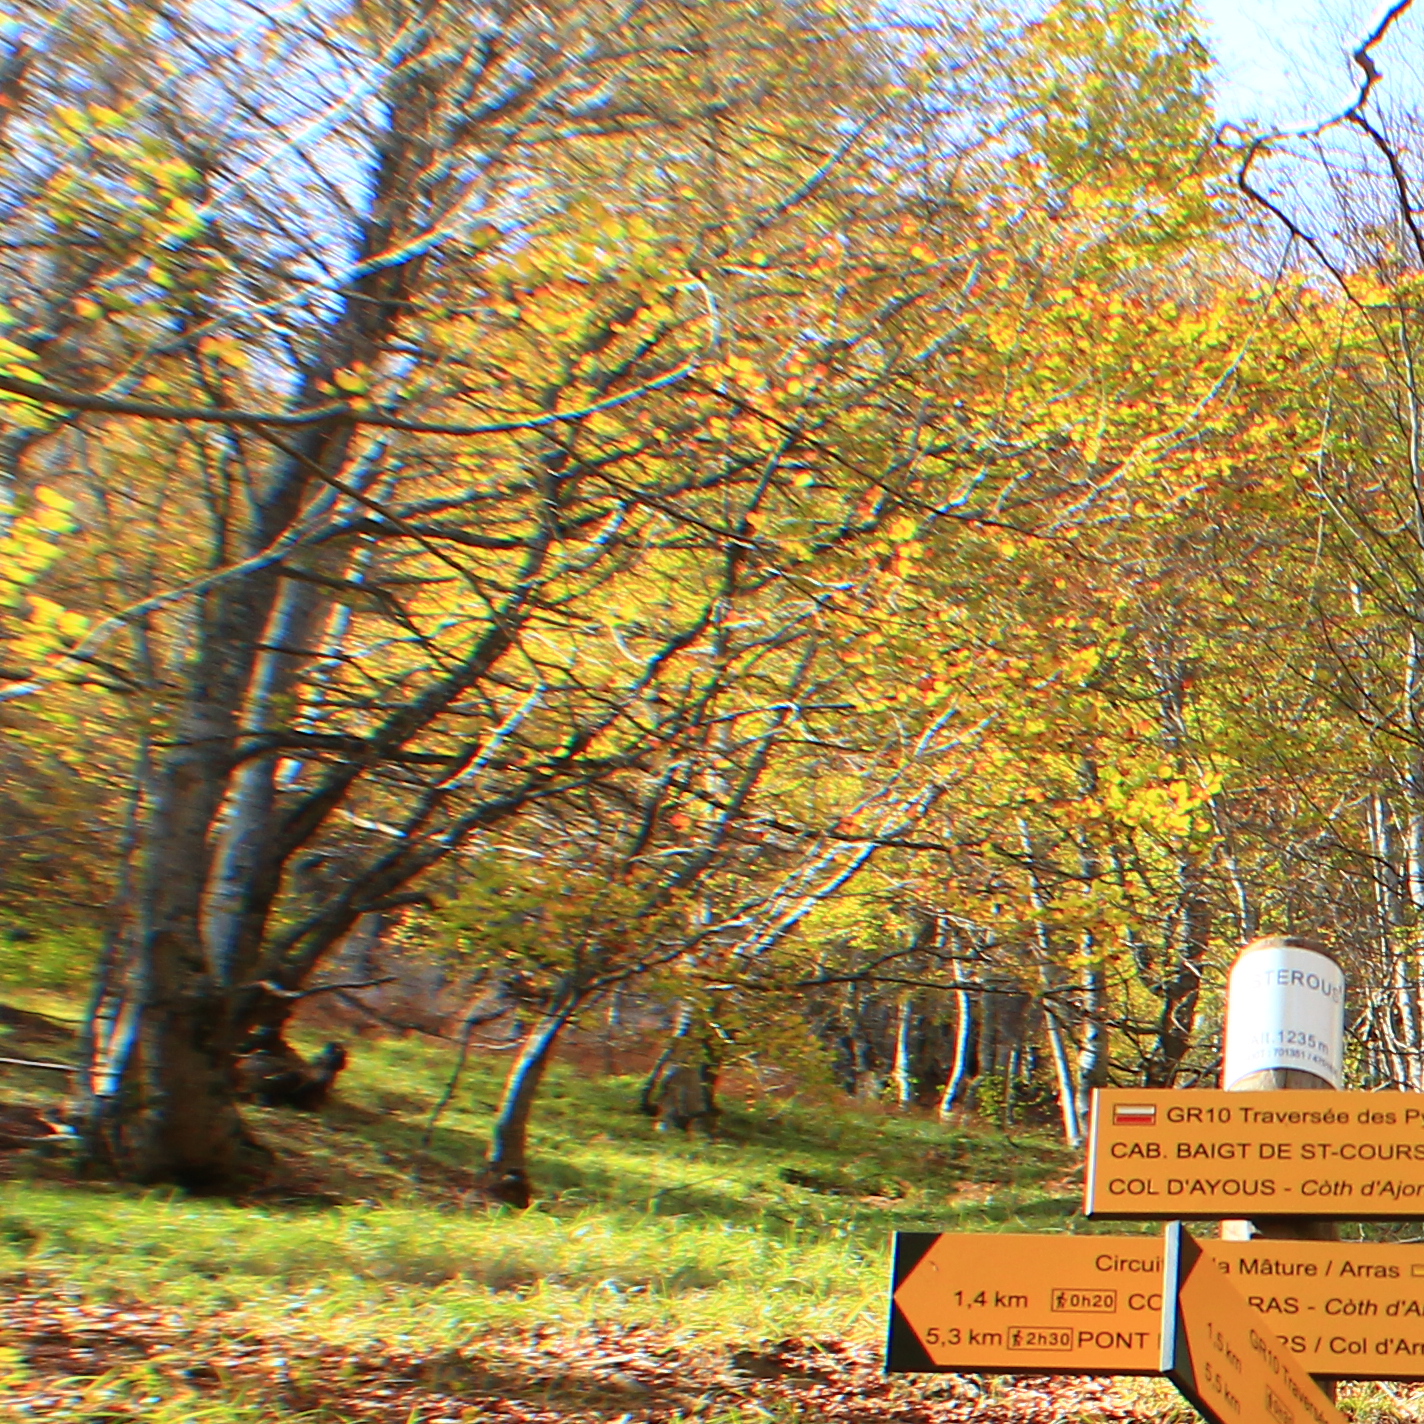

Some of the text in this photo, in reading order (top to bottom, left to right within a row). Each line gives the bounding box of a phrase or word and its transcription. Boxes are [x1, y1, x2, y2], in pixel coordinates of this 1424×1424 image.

[1166, 1106, 1231, 1124] GR10
[1239, 1107, 1349, 1125] Traversée
[1357, 1109, 1397, 1126] des
[1110, 1142, 1167, 1159] CAB.
[1176, 1142, 1251, 1160] BAIGT
[1259, 1143, 1292, 1160] DE
[1108, 1178, 1159, 1196] COL
[1166, 1178, 1276, 1196] D'AYOUS
[1300, 1178, 1353, 1197] Còth
[1094, 1254, 1164, 1274] Circui
[1239, 1257, 1317, 1277] Mâture
[1339, 1261, 1400, 1278] Arras
[953, 1290, 988, 1310] 1,4
[994, 1290, 1029, 1308] km
[1070, 1294, 1114, 1309] 0h20
[1324, 1297, 1378, 1317] Còth
[925, 1327, 962, 1347] 5,3
[968, 1328, 1003, 1346] km
[1026, 1332, 1070, 1346] 2h30
[1078, 1330, 1149, 1349] PONT
[1329, 1336, 1368, 1354] Col
[1225, 1341, 1242, 1374] km
[1250, 1328, 1279, 1375] GR10
[1224, 1383, 1241, 1416] km
